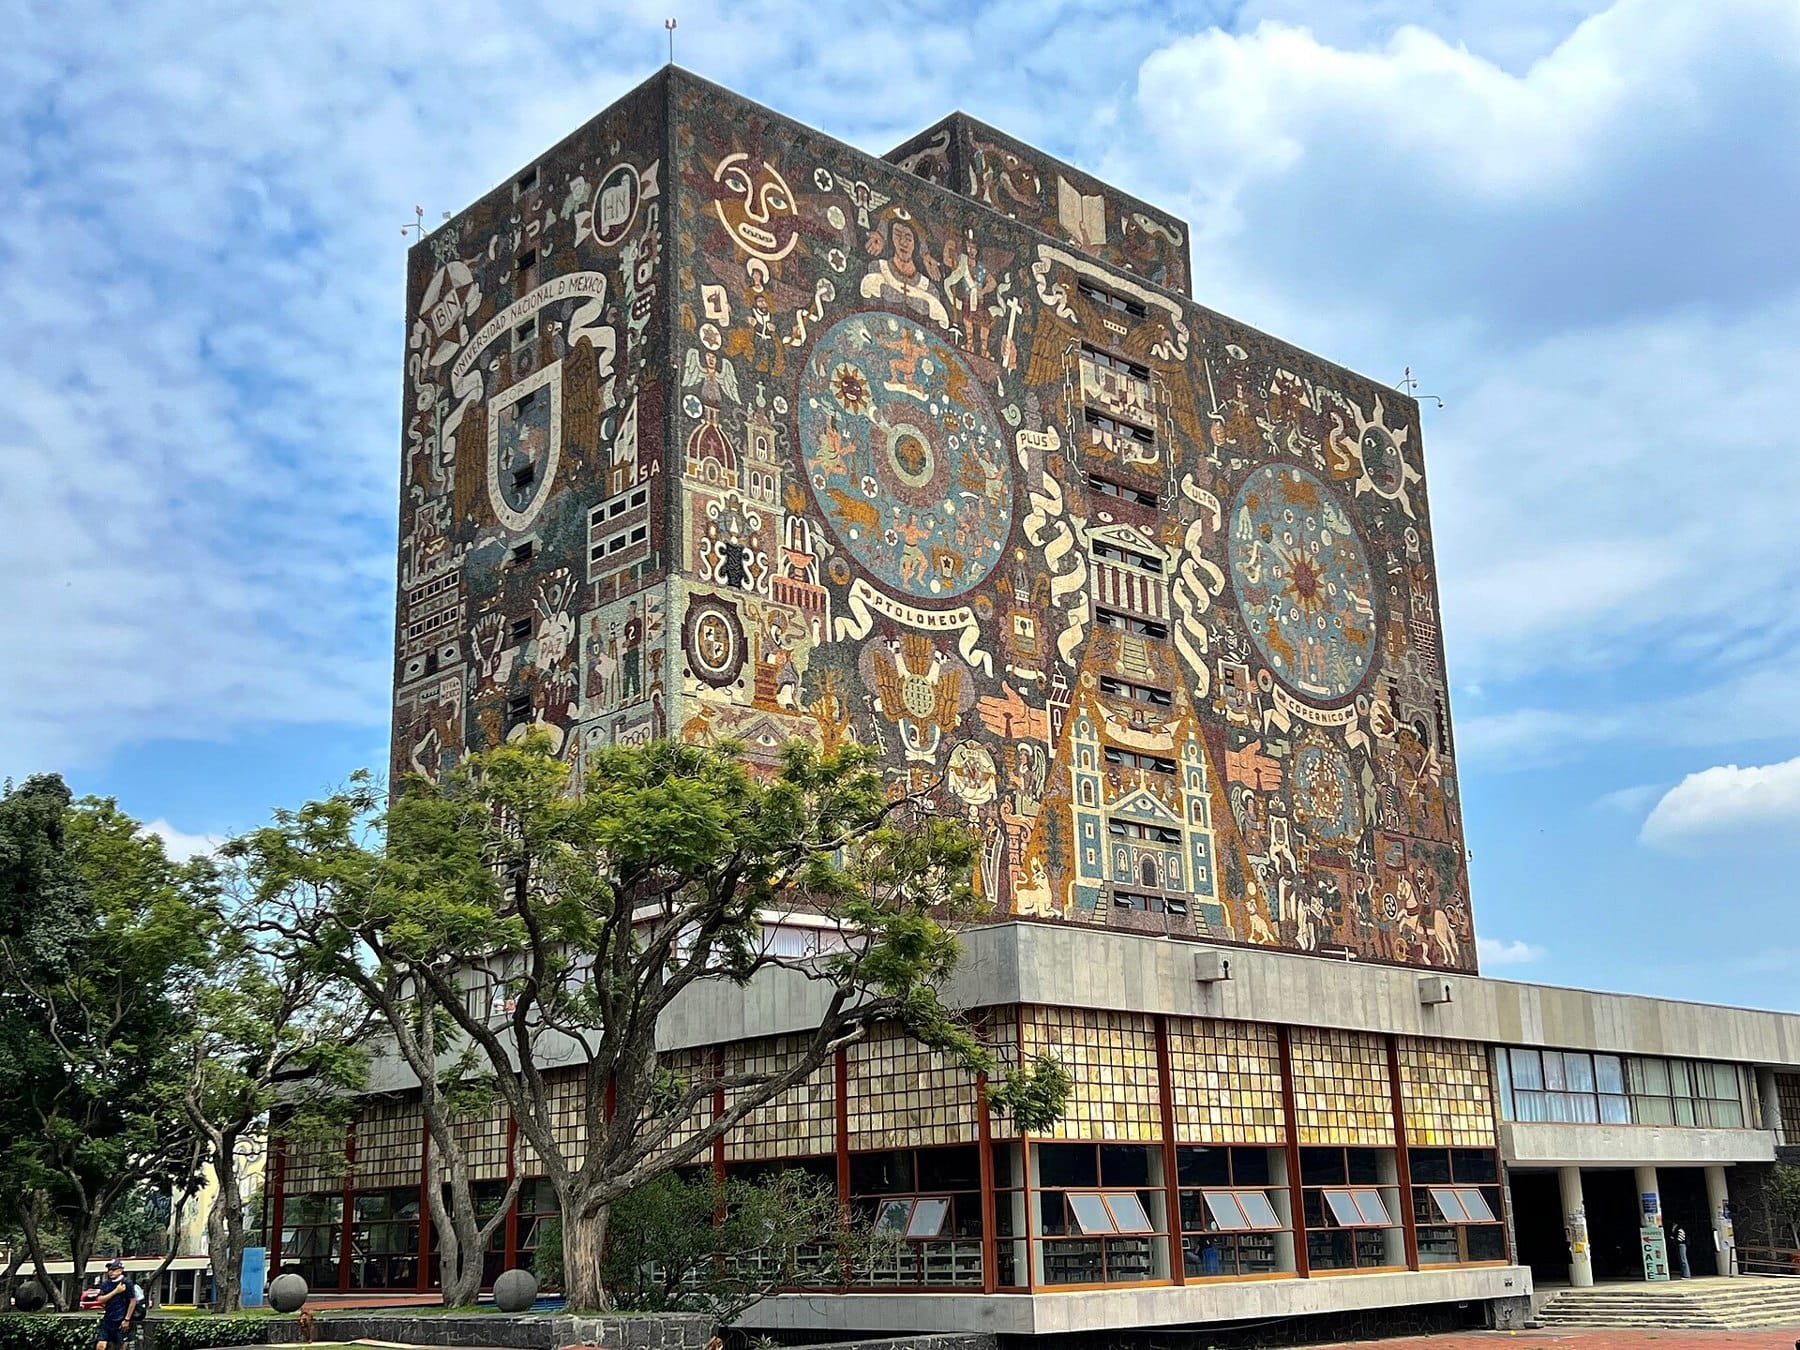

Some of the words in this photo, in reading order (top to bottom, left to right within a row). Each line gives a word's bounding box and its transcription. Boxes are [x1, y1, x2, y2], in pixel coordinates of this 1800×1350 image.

[436, 292, 457, 327] BN
[510, 288, 554, 320] NACIONAL
[569, 275, 604, 294] MEXICO
[1020, 432, 1048, 447] PLUS
[1192, 487, 1218, 511] ULTRA
[875, 596, 957, 626] PTOLOMEO
[1288, 700, 1343, 722] COPERNICO
